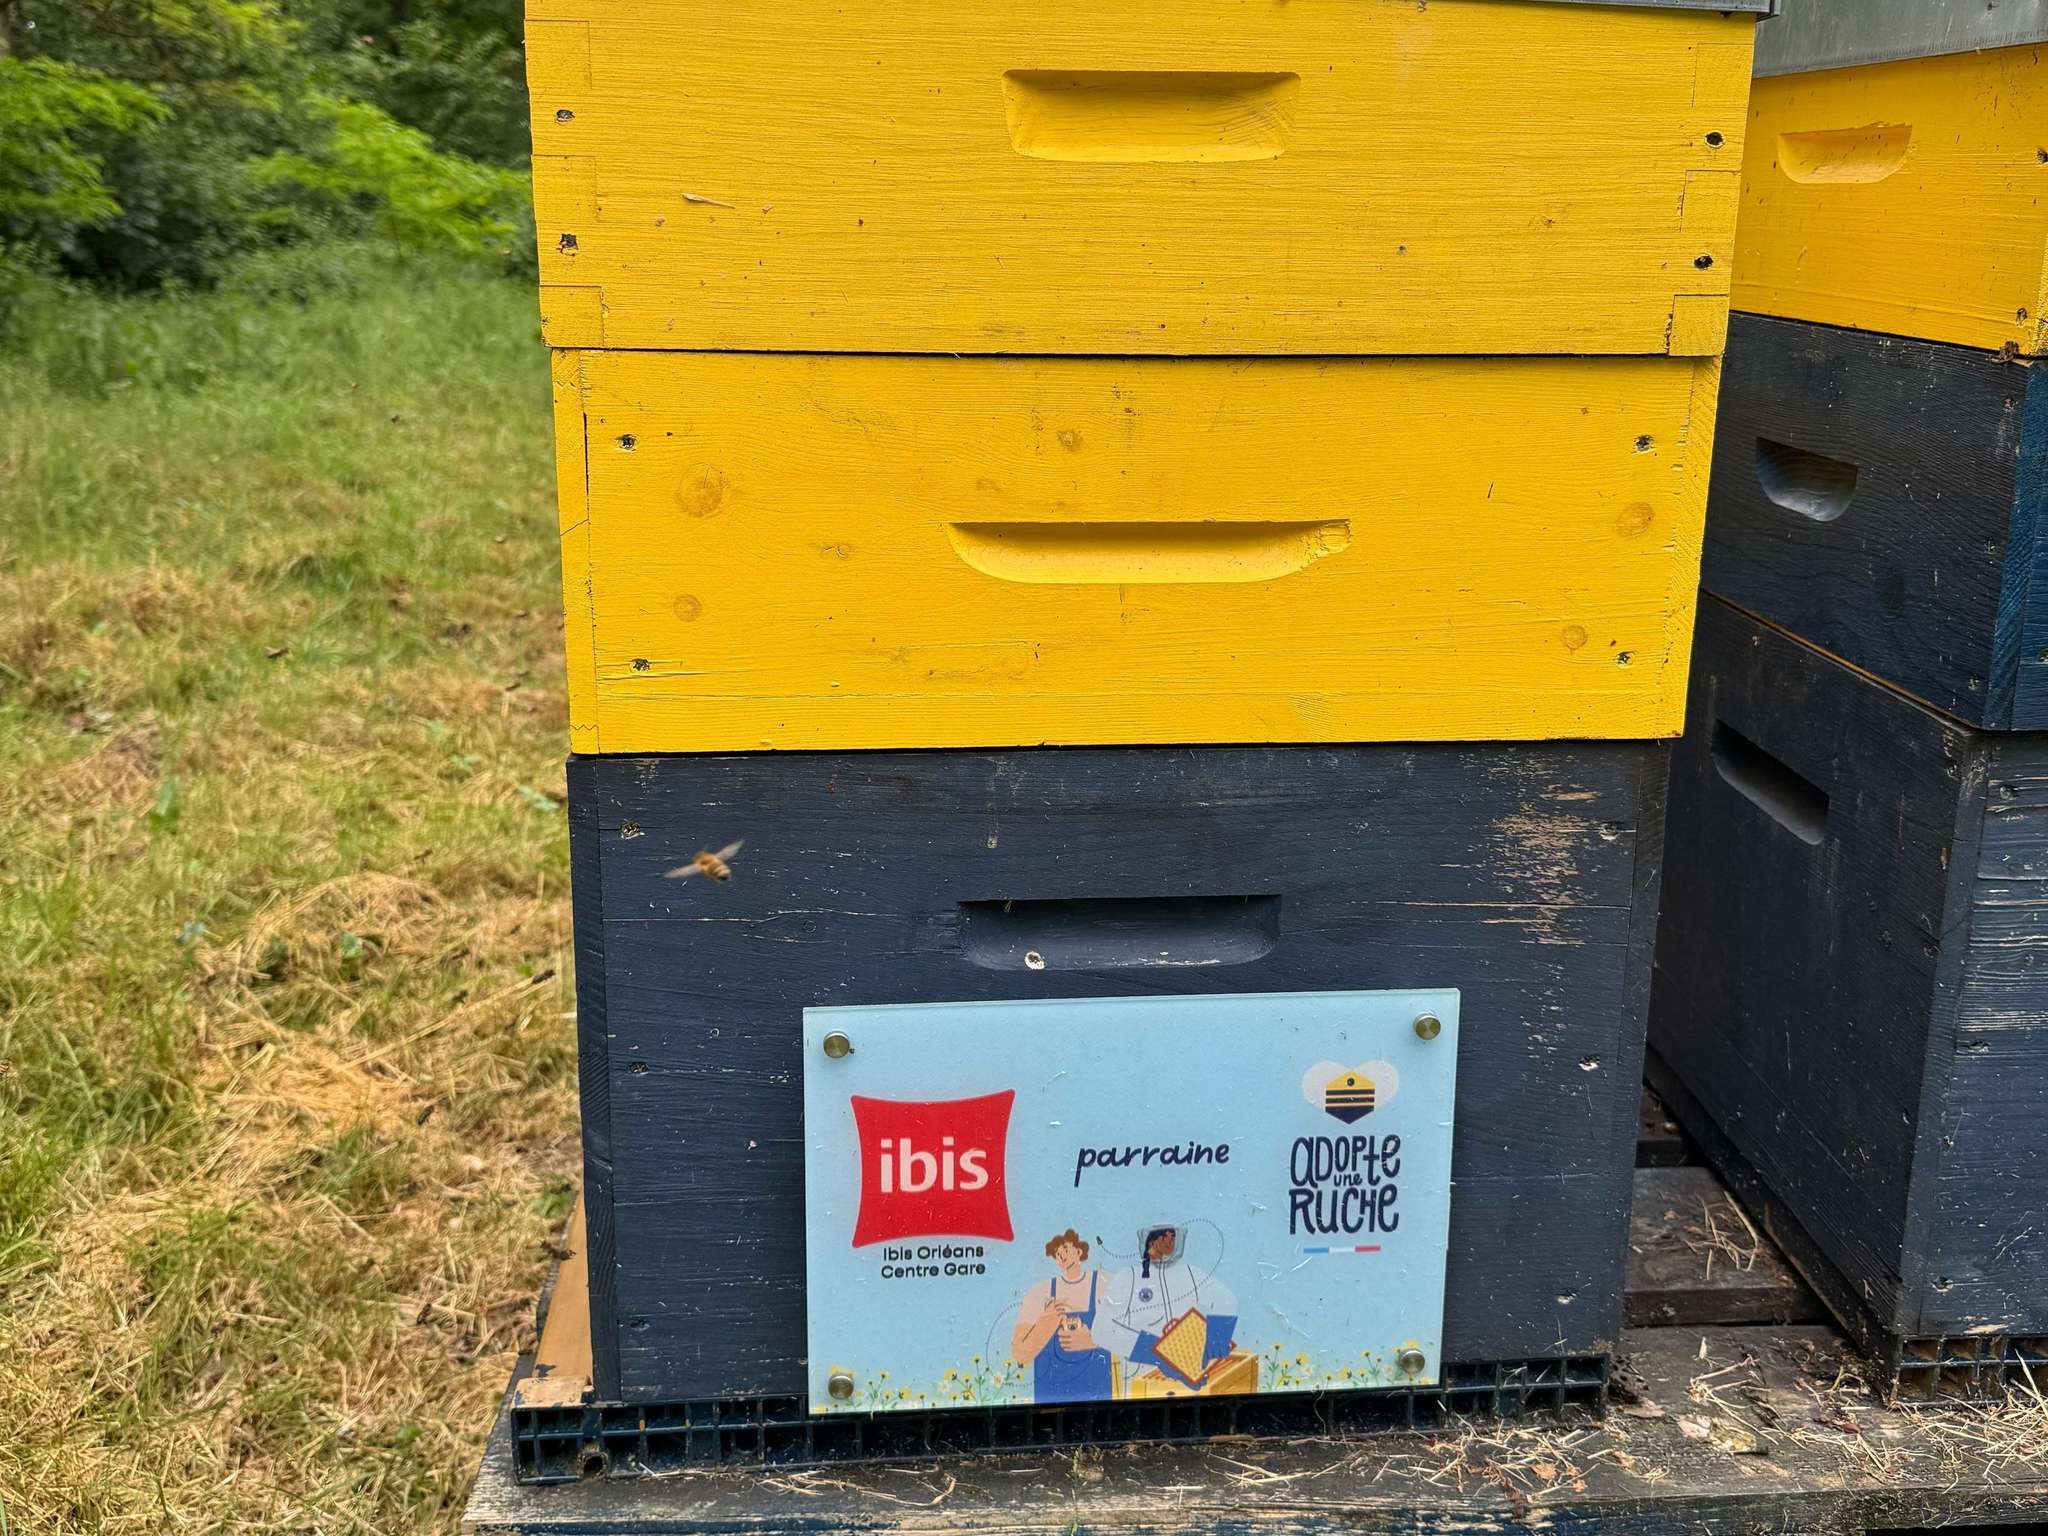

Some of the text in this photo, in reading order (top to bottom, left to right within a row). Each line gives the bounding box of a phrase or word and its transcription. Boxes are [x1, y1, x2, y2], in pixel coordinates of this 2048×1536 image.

[880, 1136, 989, 1194] ibis
[1074, 1141, 1230, 1188] parraine
[1333, 1173, 1363, 1187] une
[883, 1244, 984, 1261] Ibis Orléans
[881, 1262, 986, 1279] Centre Gare
